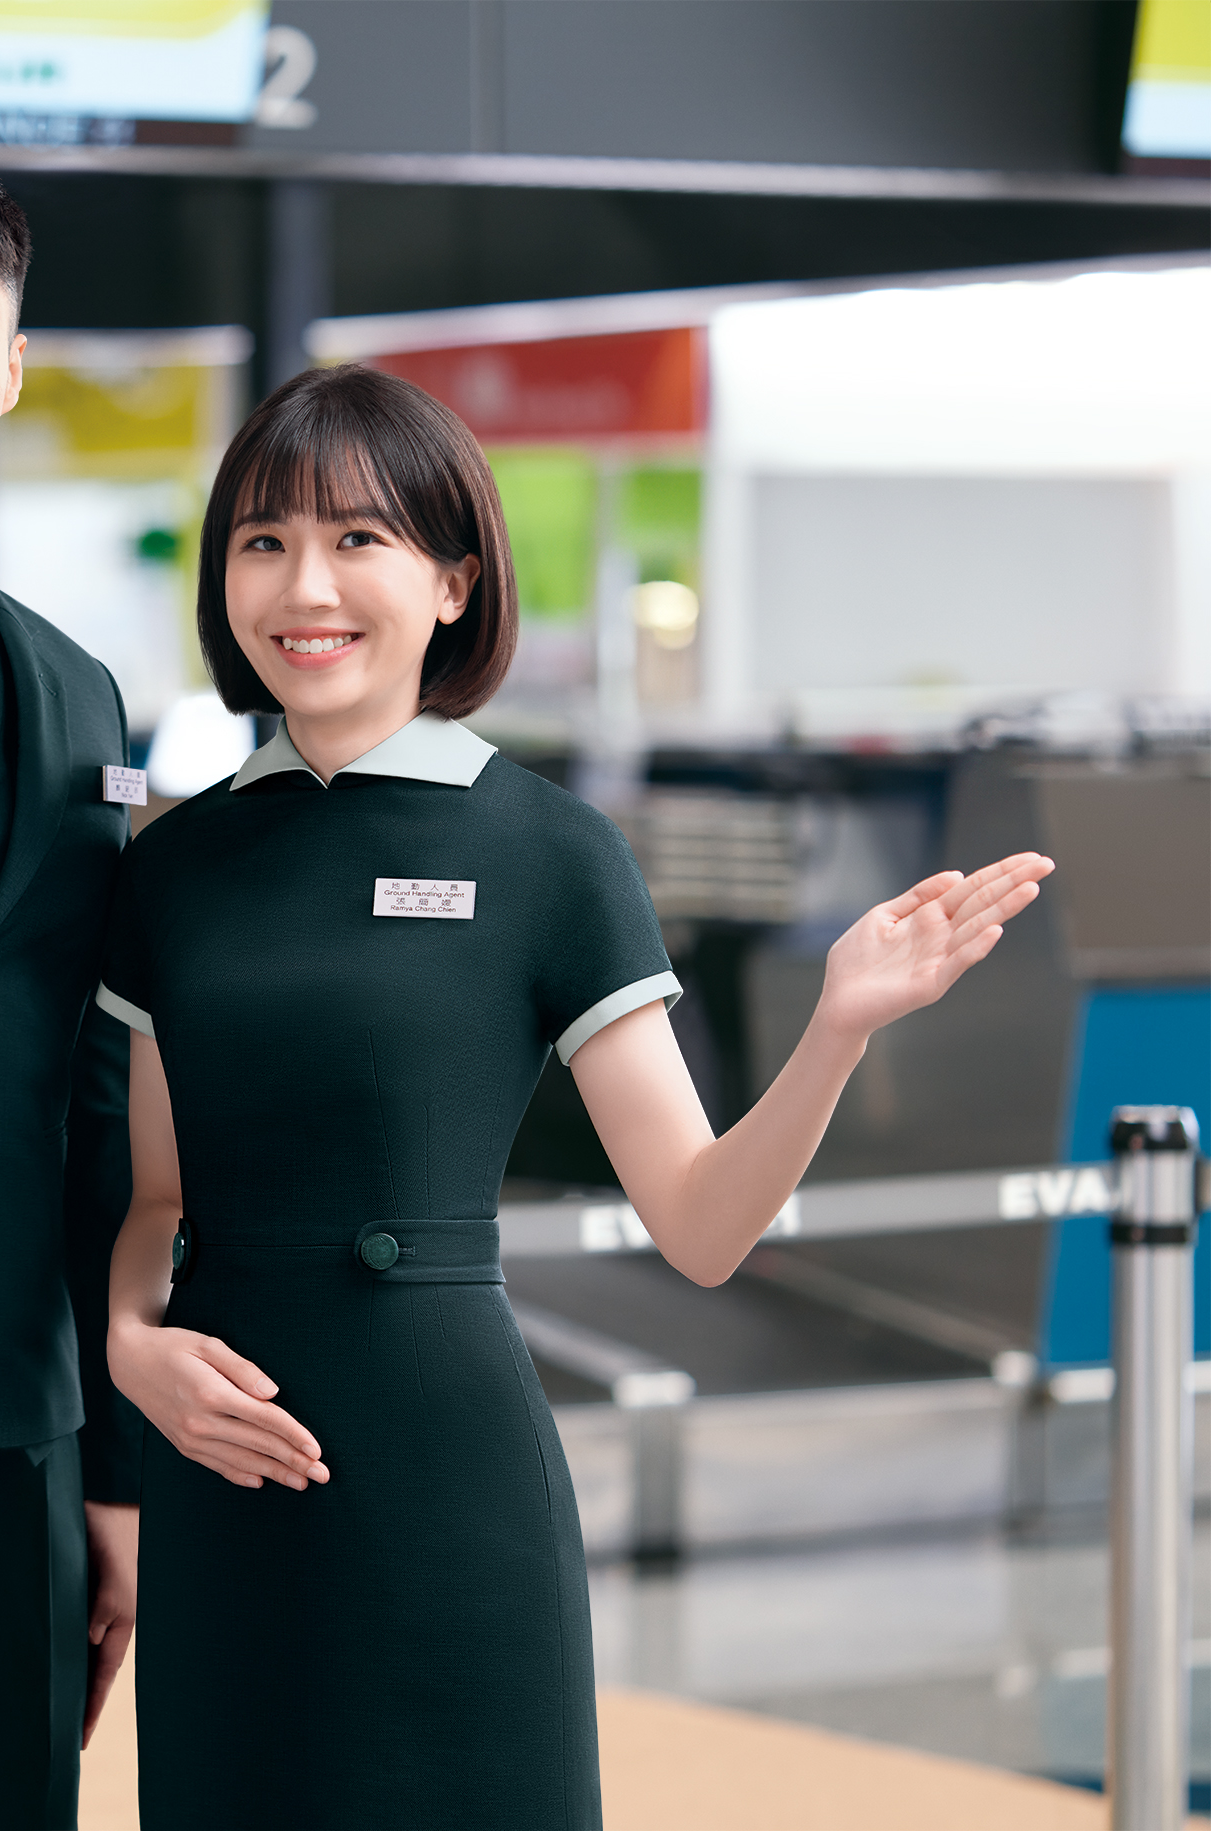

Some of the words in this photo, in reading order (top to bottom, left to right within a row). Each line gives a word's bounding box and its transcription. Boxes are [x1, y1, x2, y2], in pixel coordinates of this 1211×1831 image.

[254, 24, 319, 129] 2
[415, 905, 436, 913] Chang
[998, 1167, 1124, 1220] EVA
